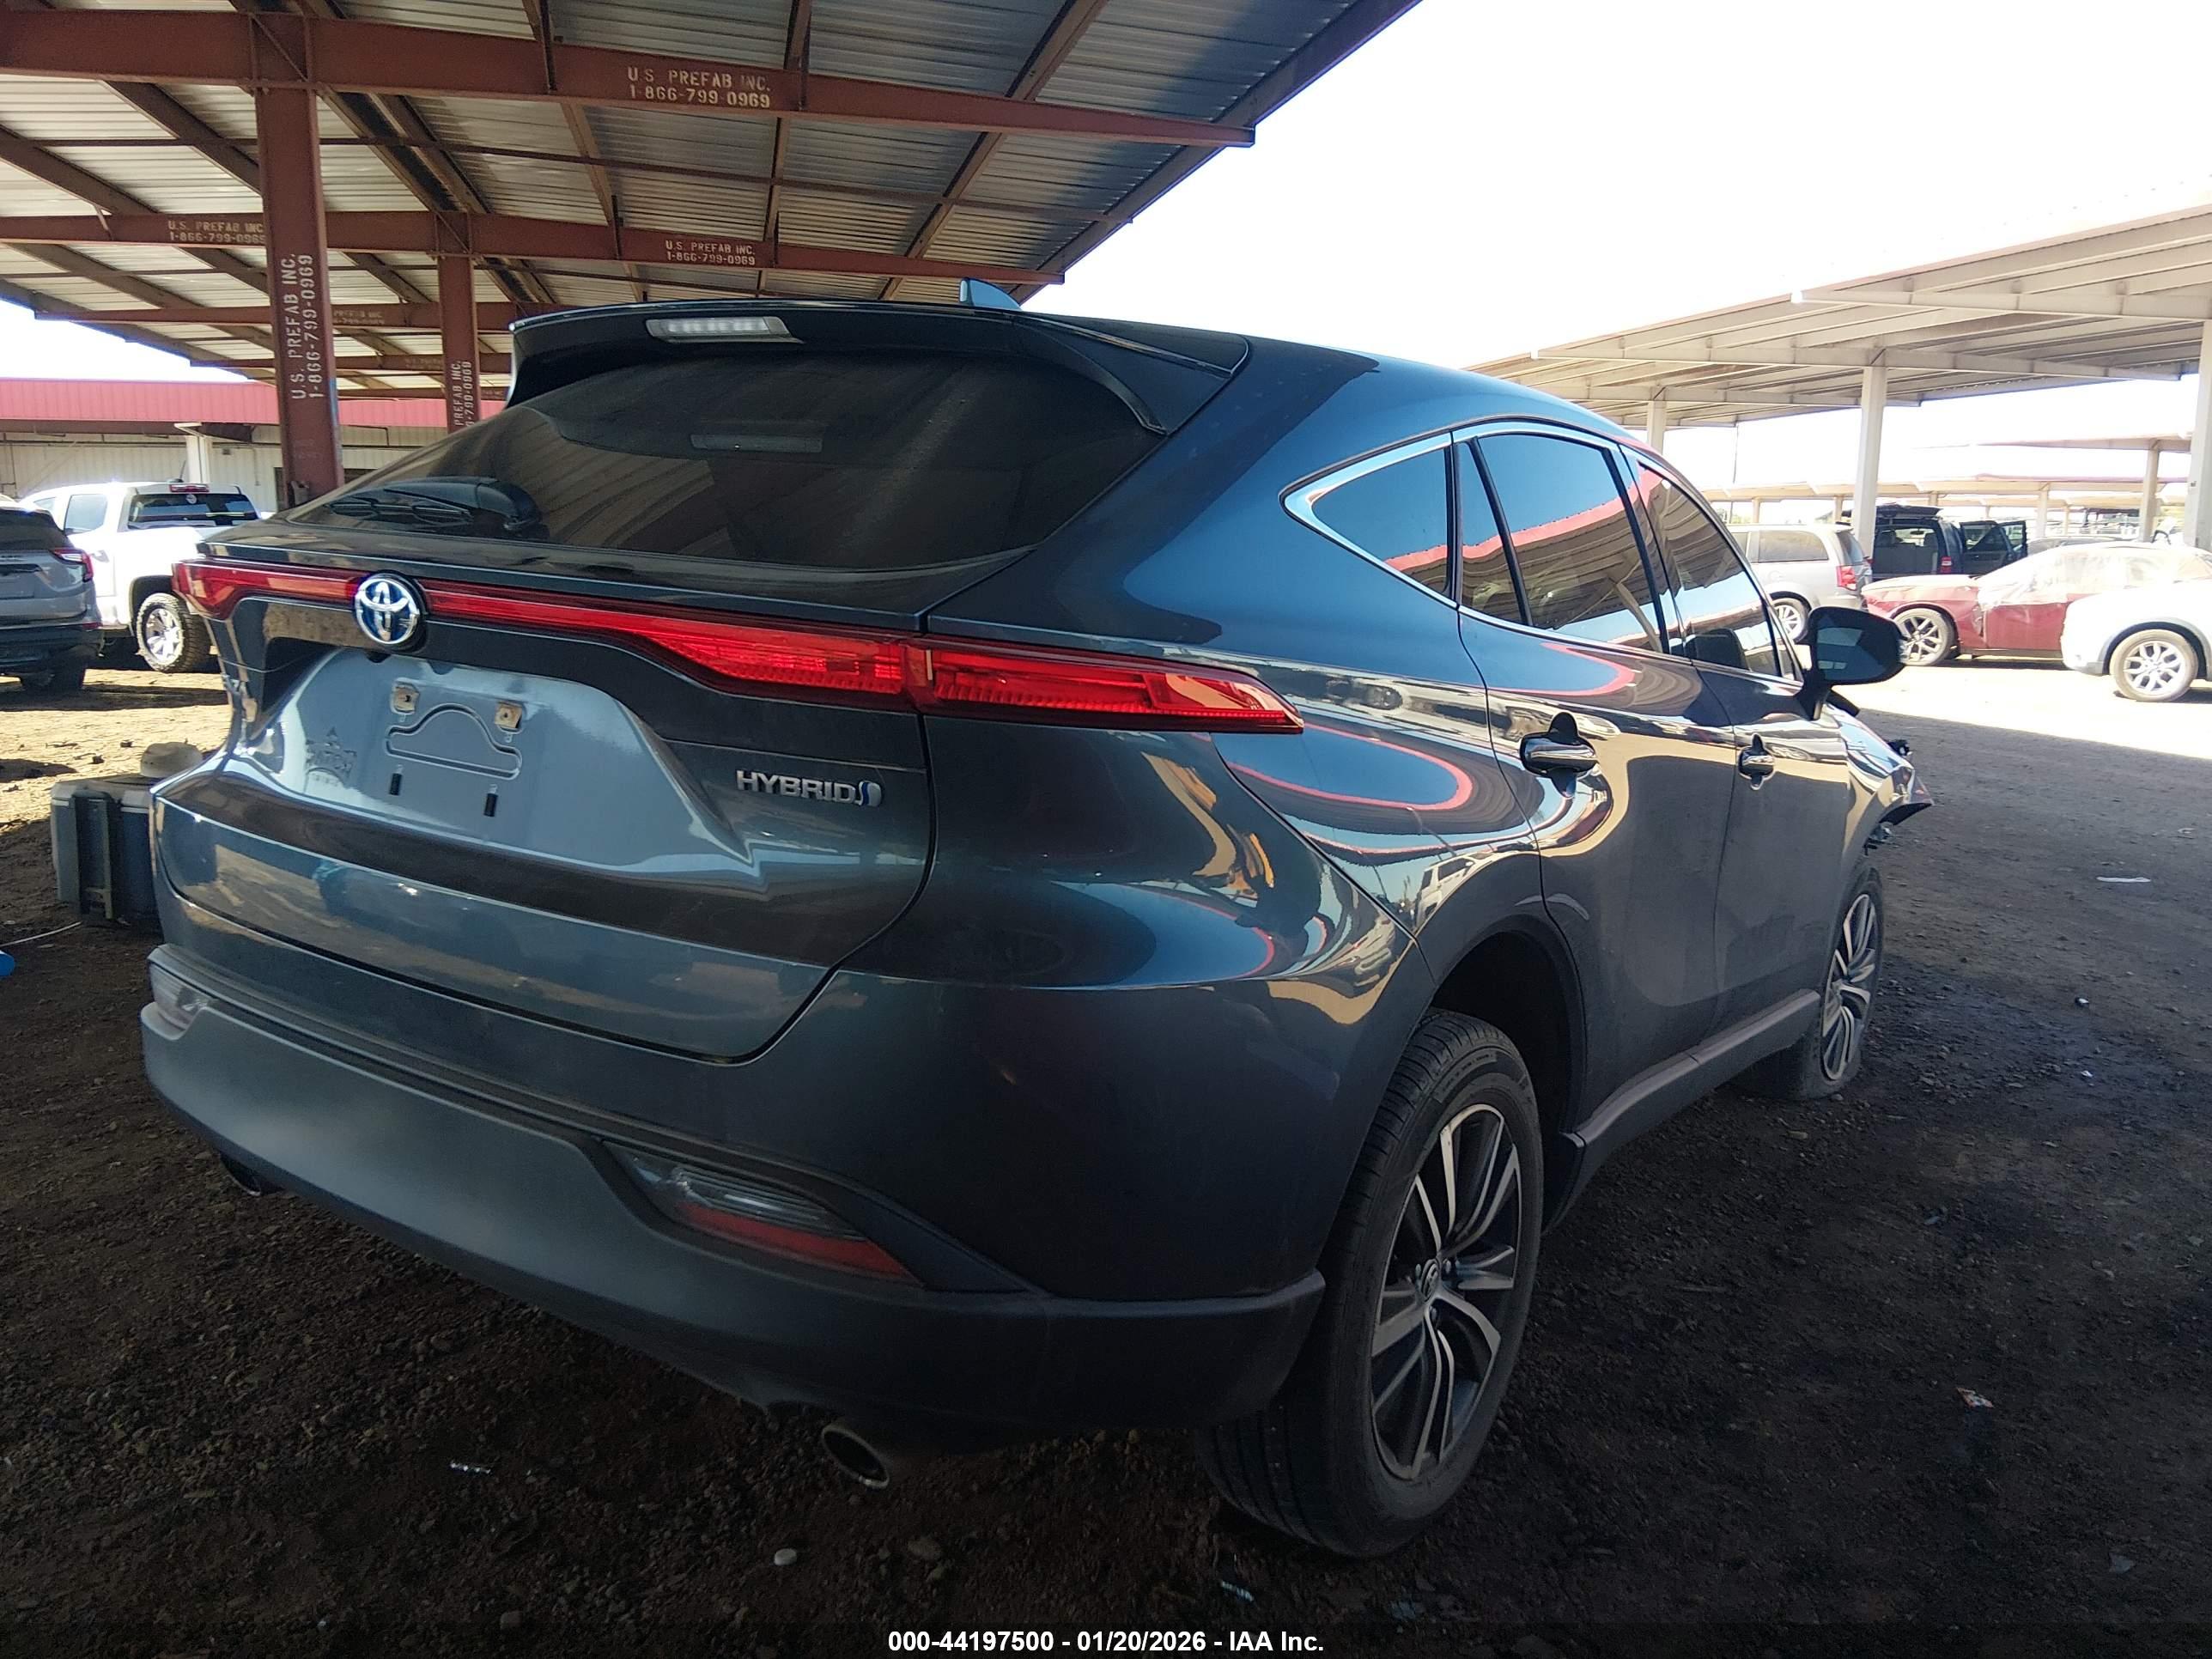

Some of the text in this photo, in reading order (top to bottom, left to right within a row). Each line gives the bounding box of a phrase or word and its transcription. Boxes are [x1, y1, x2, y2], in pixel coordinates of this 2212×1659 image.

[669, 69, 732, 88] PREFAB
[740, 75, 771, 93] INC.
[196, 221, 240, 232] PREFAB
[691, 242, 731, 253] PREFAB
[736, 245, 756, 255] INC.
[281, 253, 307, 399] U.S. PREFAB INC.
[298, 254, 325, 398] 1-866-799-0969
[453, 386, 465, 426] PREFAB
[737, 769, 856, 804] HYBRID
